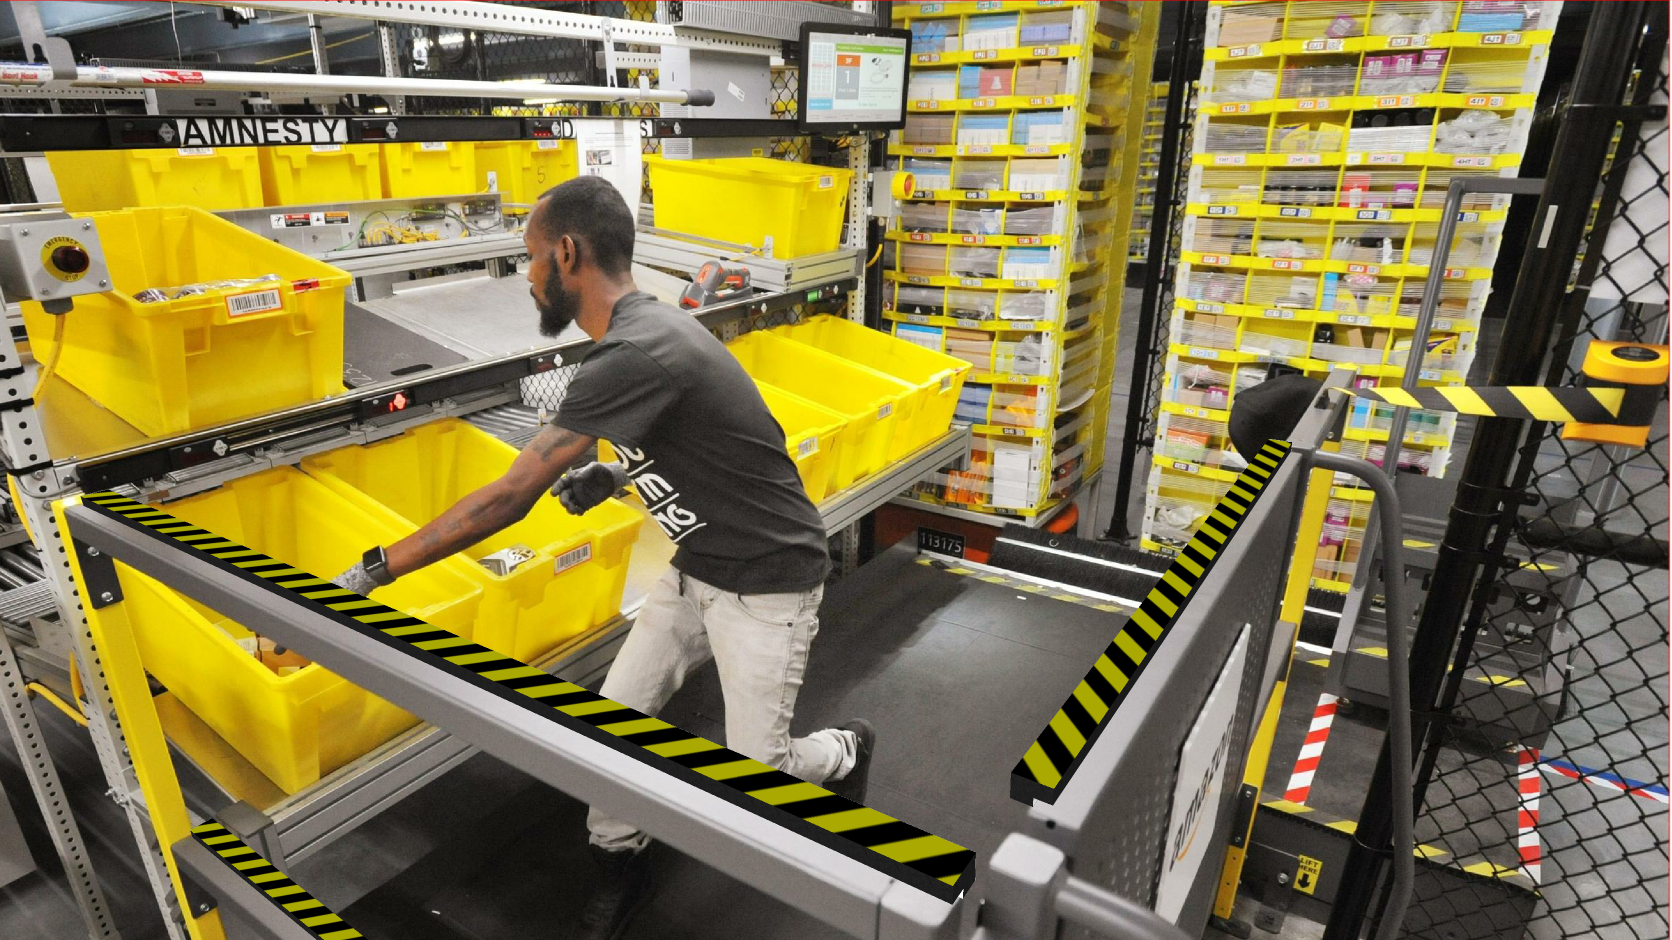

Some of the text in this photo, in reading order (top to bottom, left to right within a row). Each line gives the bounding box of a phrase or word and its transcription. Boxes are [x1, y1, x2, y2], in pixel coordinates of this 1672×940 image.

[844, 70, 850, 84] 1
[183, 118, 339, 145] AMNESTY
[537, 165, 546, 184] 5
[44, 236, 79, 250] EMERGENCY
[65, 273, 79, 281] STOP
[921, 532, 962, 553] 113175
[1300, 857, 1319, 868] LIFT
